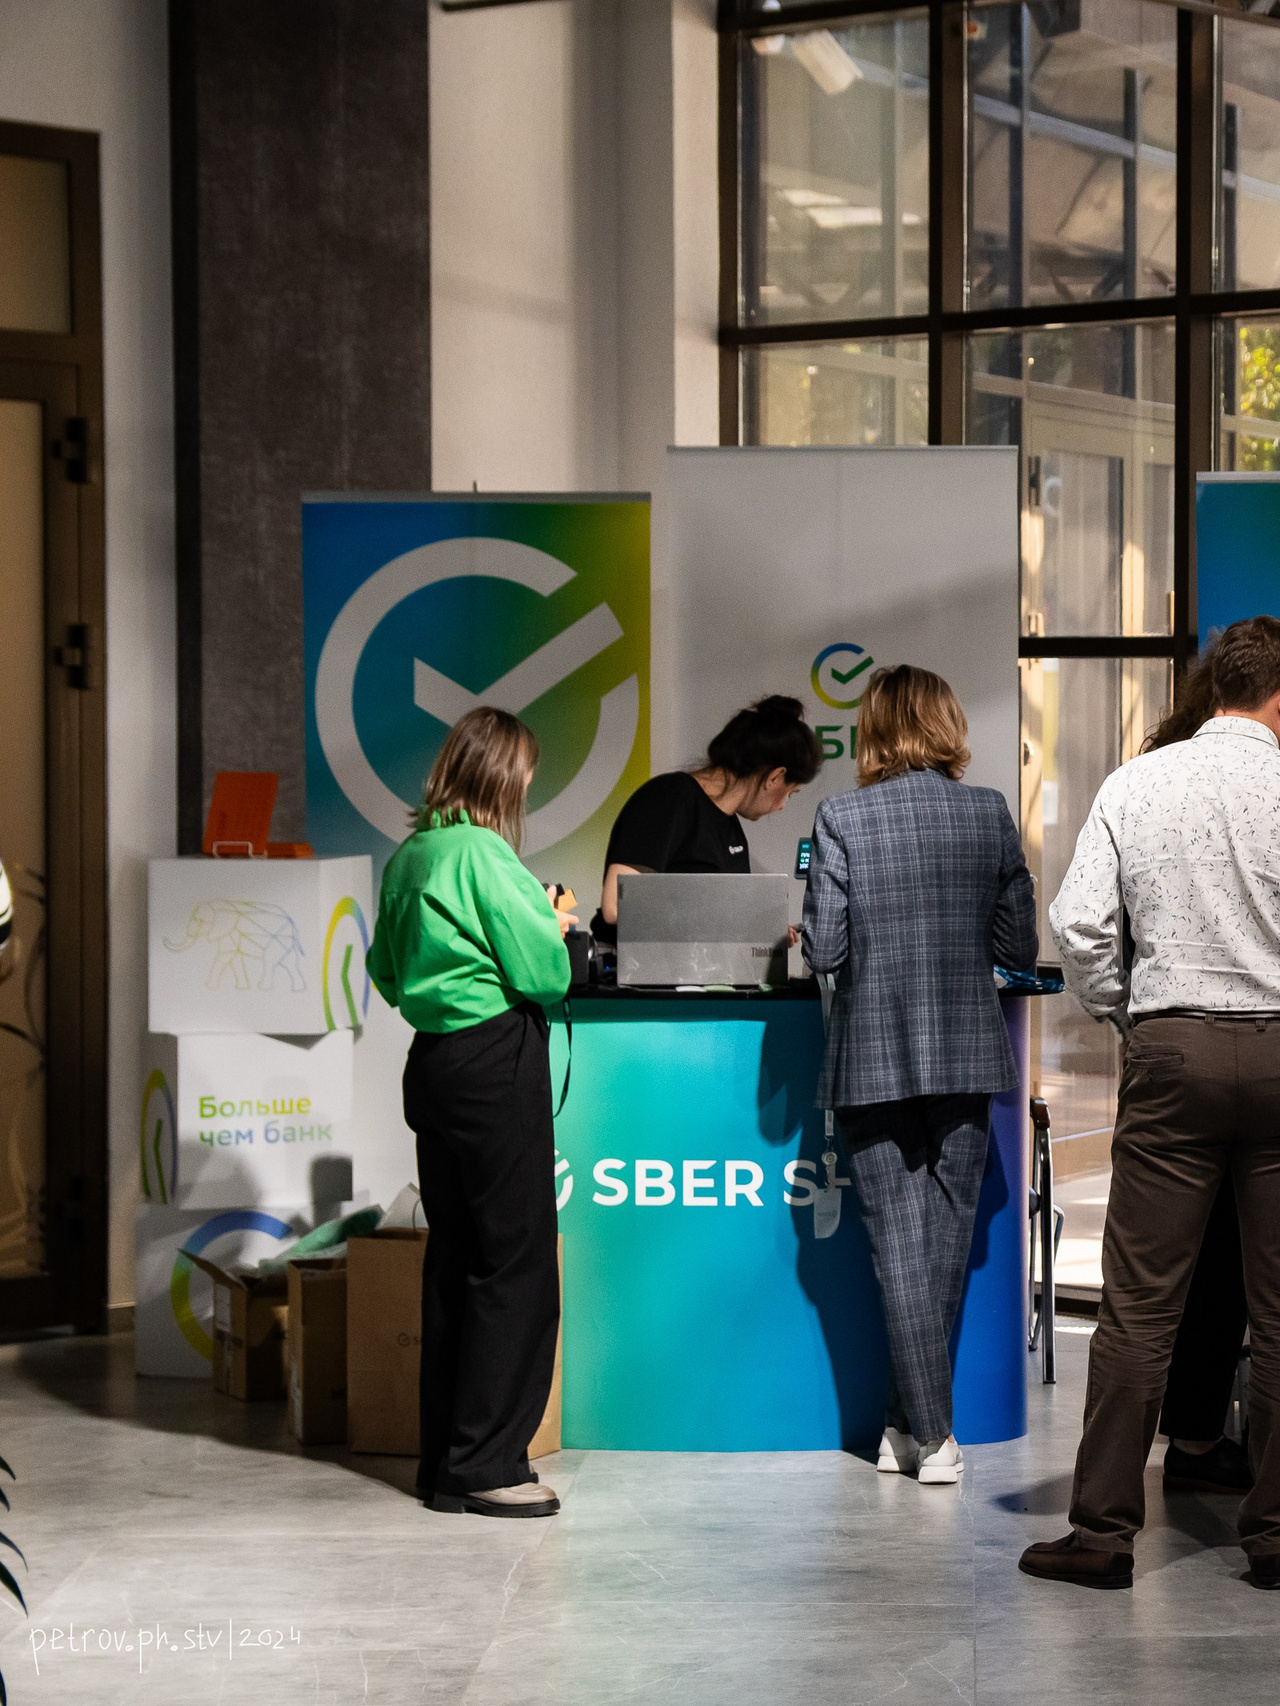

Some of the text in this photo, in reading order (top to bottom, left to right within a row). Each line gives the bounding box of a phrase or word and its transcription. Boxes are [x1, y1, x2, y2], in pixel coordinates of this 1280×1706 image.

[199, 1095, 312, 1119] Больше
[199, 1119, 332, 1147] чем банк
[592, 1158, 764, 1207] SBER
